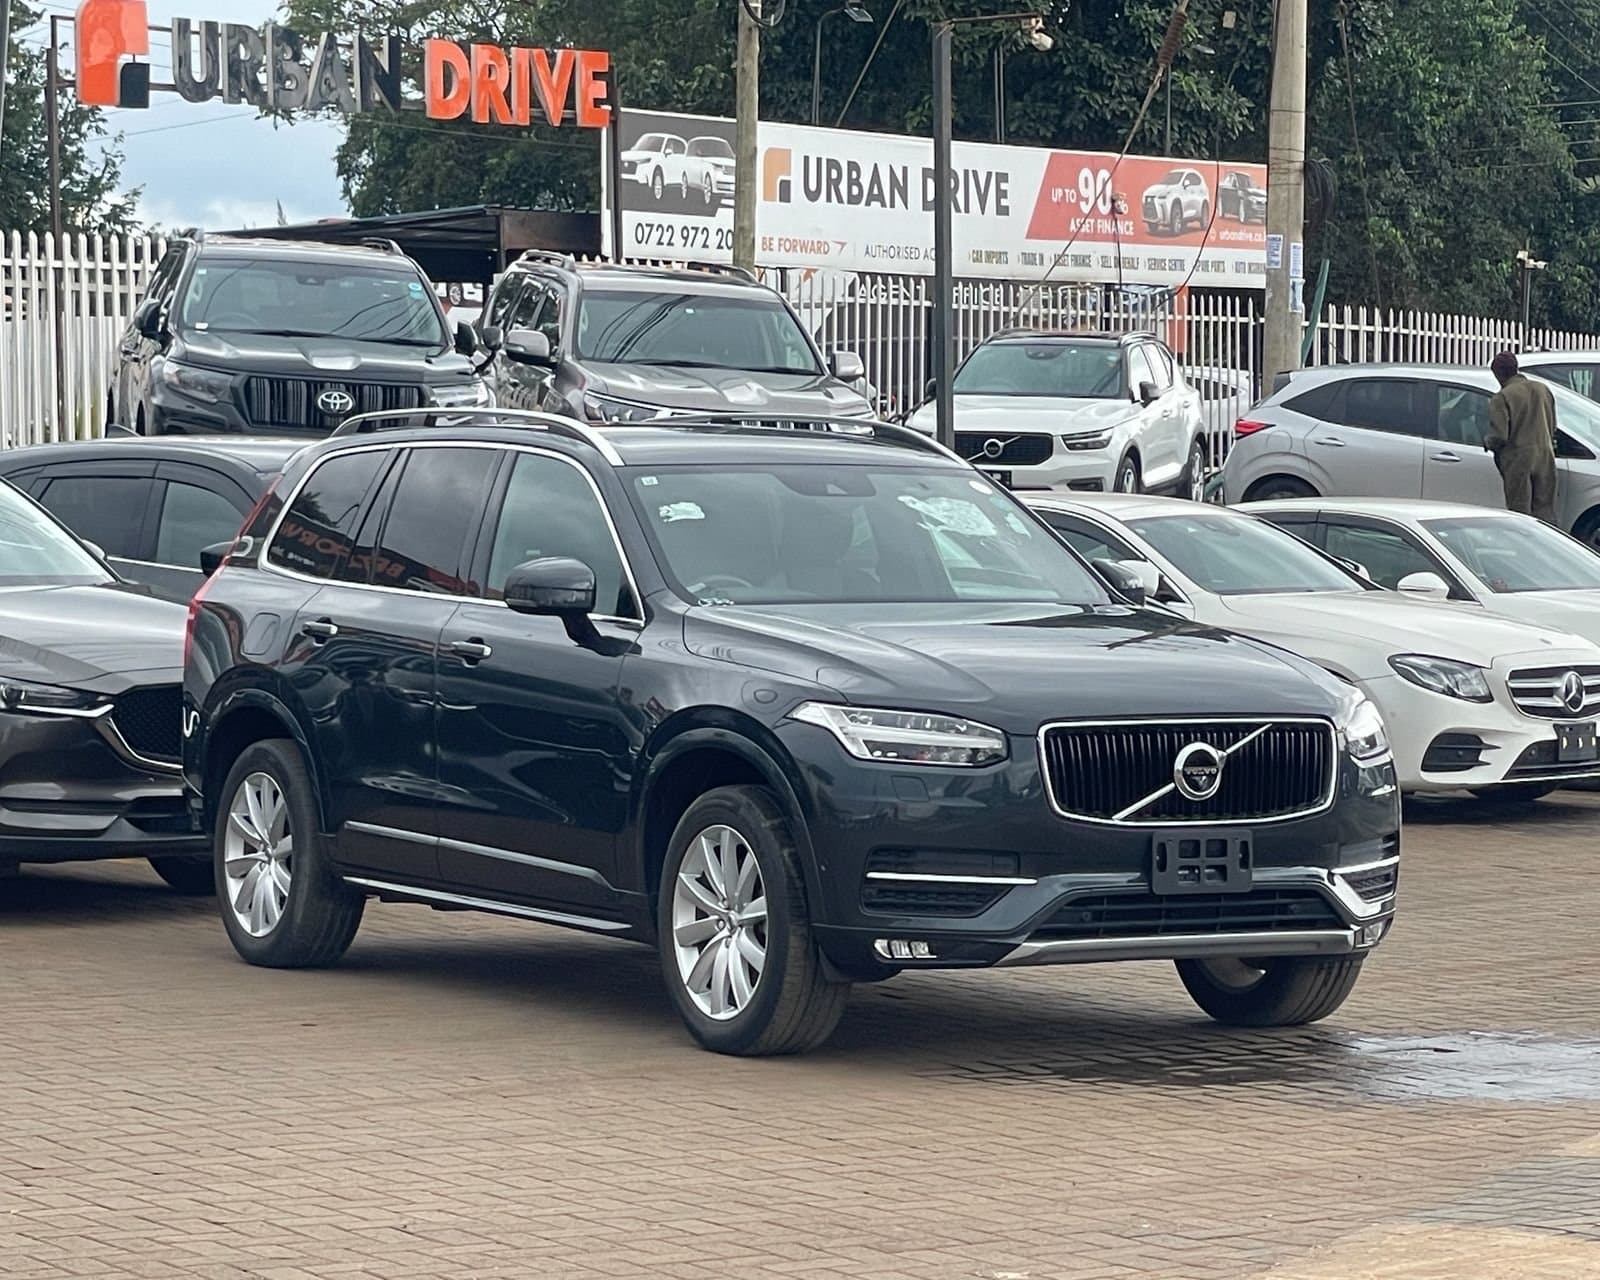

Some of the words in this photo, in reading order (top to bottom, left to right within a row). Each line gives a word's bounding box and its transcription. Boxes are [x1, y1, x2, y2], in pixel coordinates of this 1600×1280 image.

[172, 17, 400, 114] URBAN
[423, 38, 609, 128] DRIVE
[803, 155, 909, 210] URBAN
[922, 167, 1010, 216] DRIVE
[1052, 187, 1064, 201] UP
[1065, 188, 1077, 202] TO
[1070, 218, 1094, 233] ASSET
[1096, 219, 1134, 236] FINANCE
[635, 222, 675, 247] 0722
[681, 225, 709, 249] 972
[715, 228, 735, 251] 20
[761, 236, 774, 252] BE
[778, 238, 830, 255] FORWARD
[864, 244, 920, 262] AUTHORISED
[972, 249, 983, 264] CAR
[952, 286, 1002, 305] FFICE
[1185, 767, 1217, 775] VOLVO
